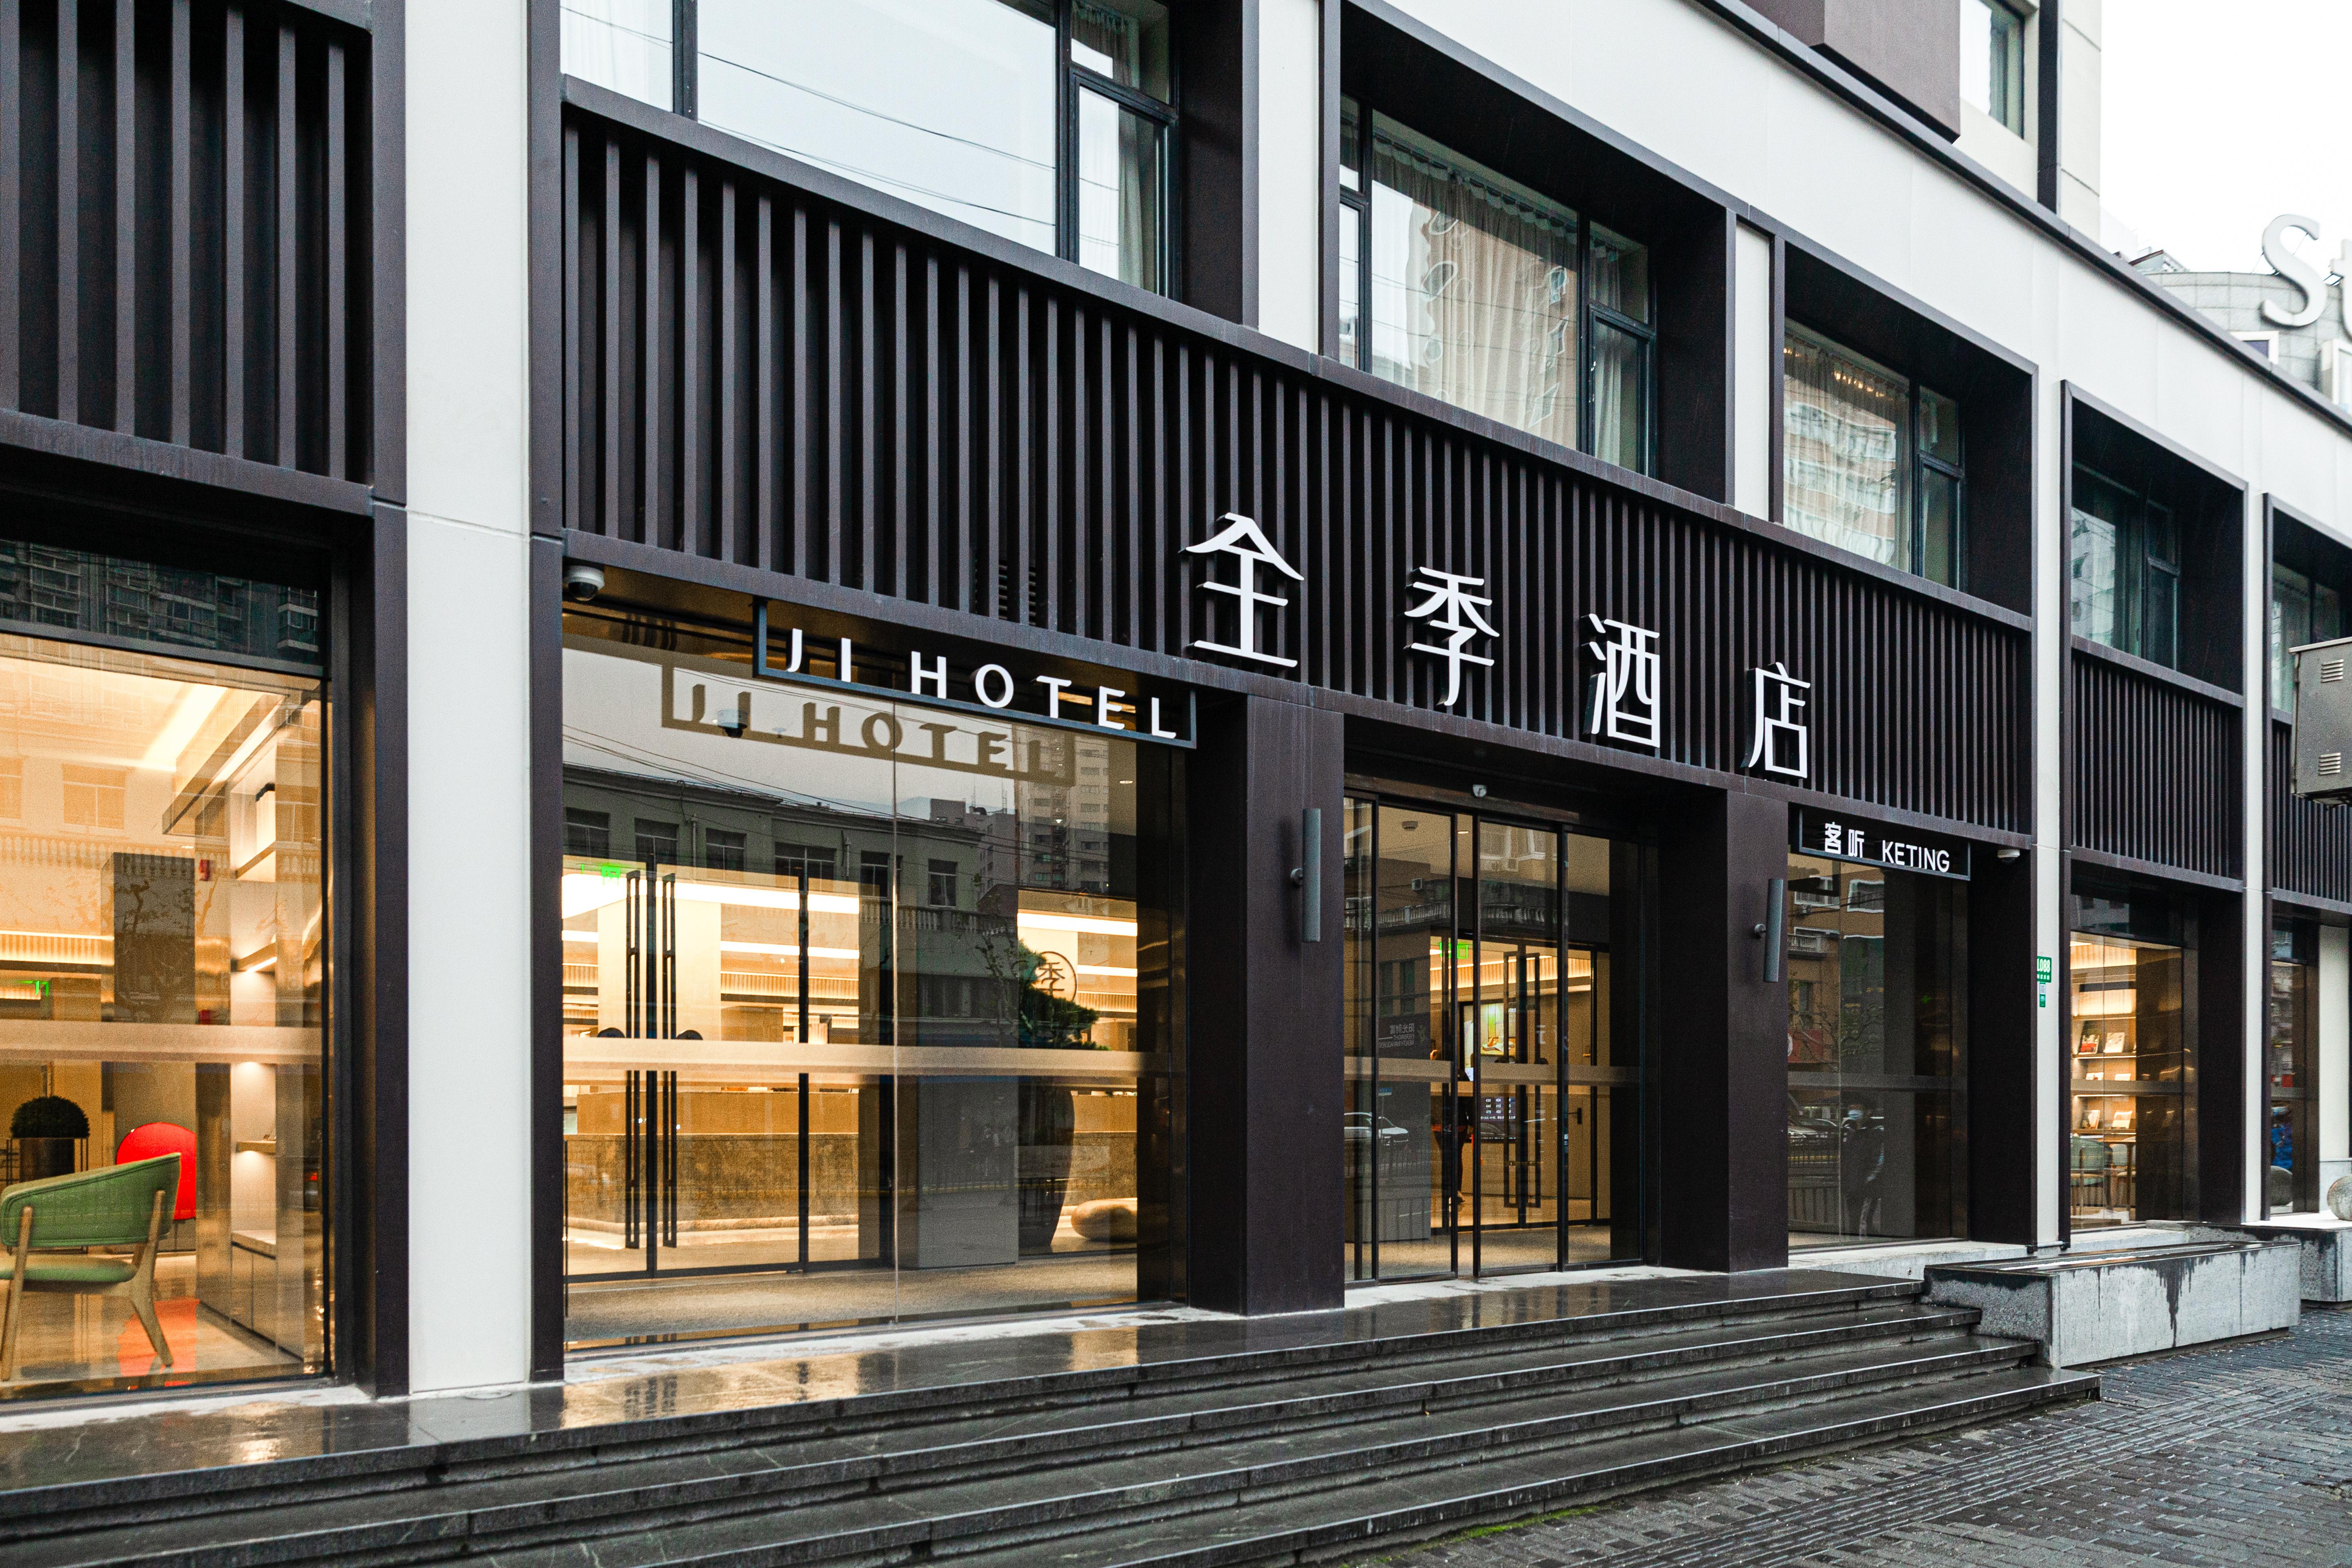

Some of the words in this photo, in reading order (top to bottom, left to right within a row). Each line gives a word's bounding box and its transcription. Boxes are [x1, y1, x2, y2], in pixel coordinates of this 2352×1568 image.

[785, 628, 851, 683] JI
[911, 651, 1177, 740] HOTEL
[1186, 512, 1811, 778] 全季酒店
[1824, 821, 1864, 858] 客听
[1881, 840, 1950, 873] KETING
